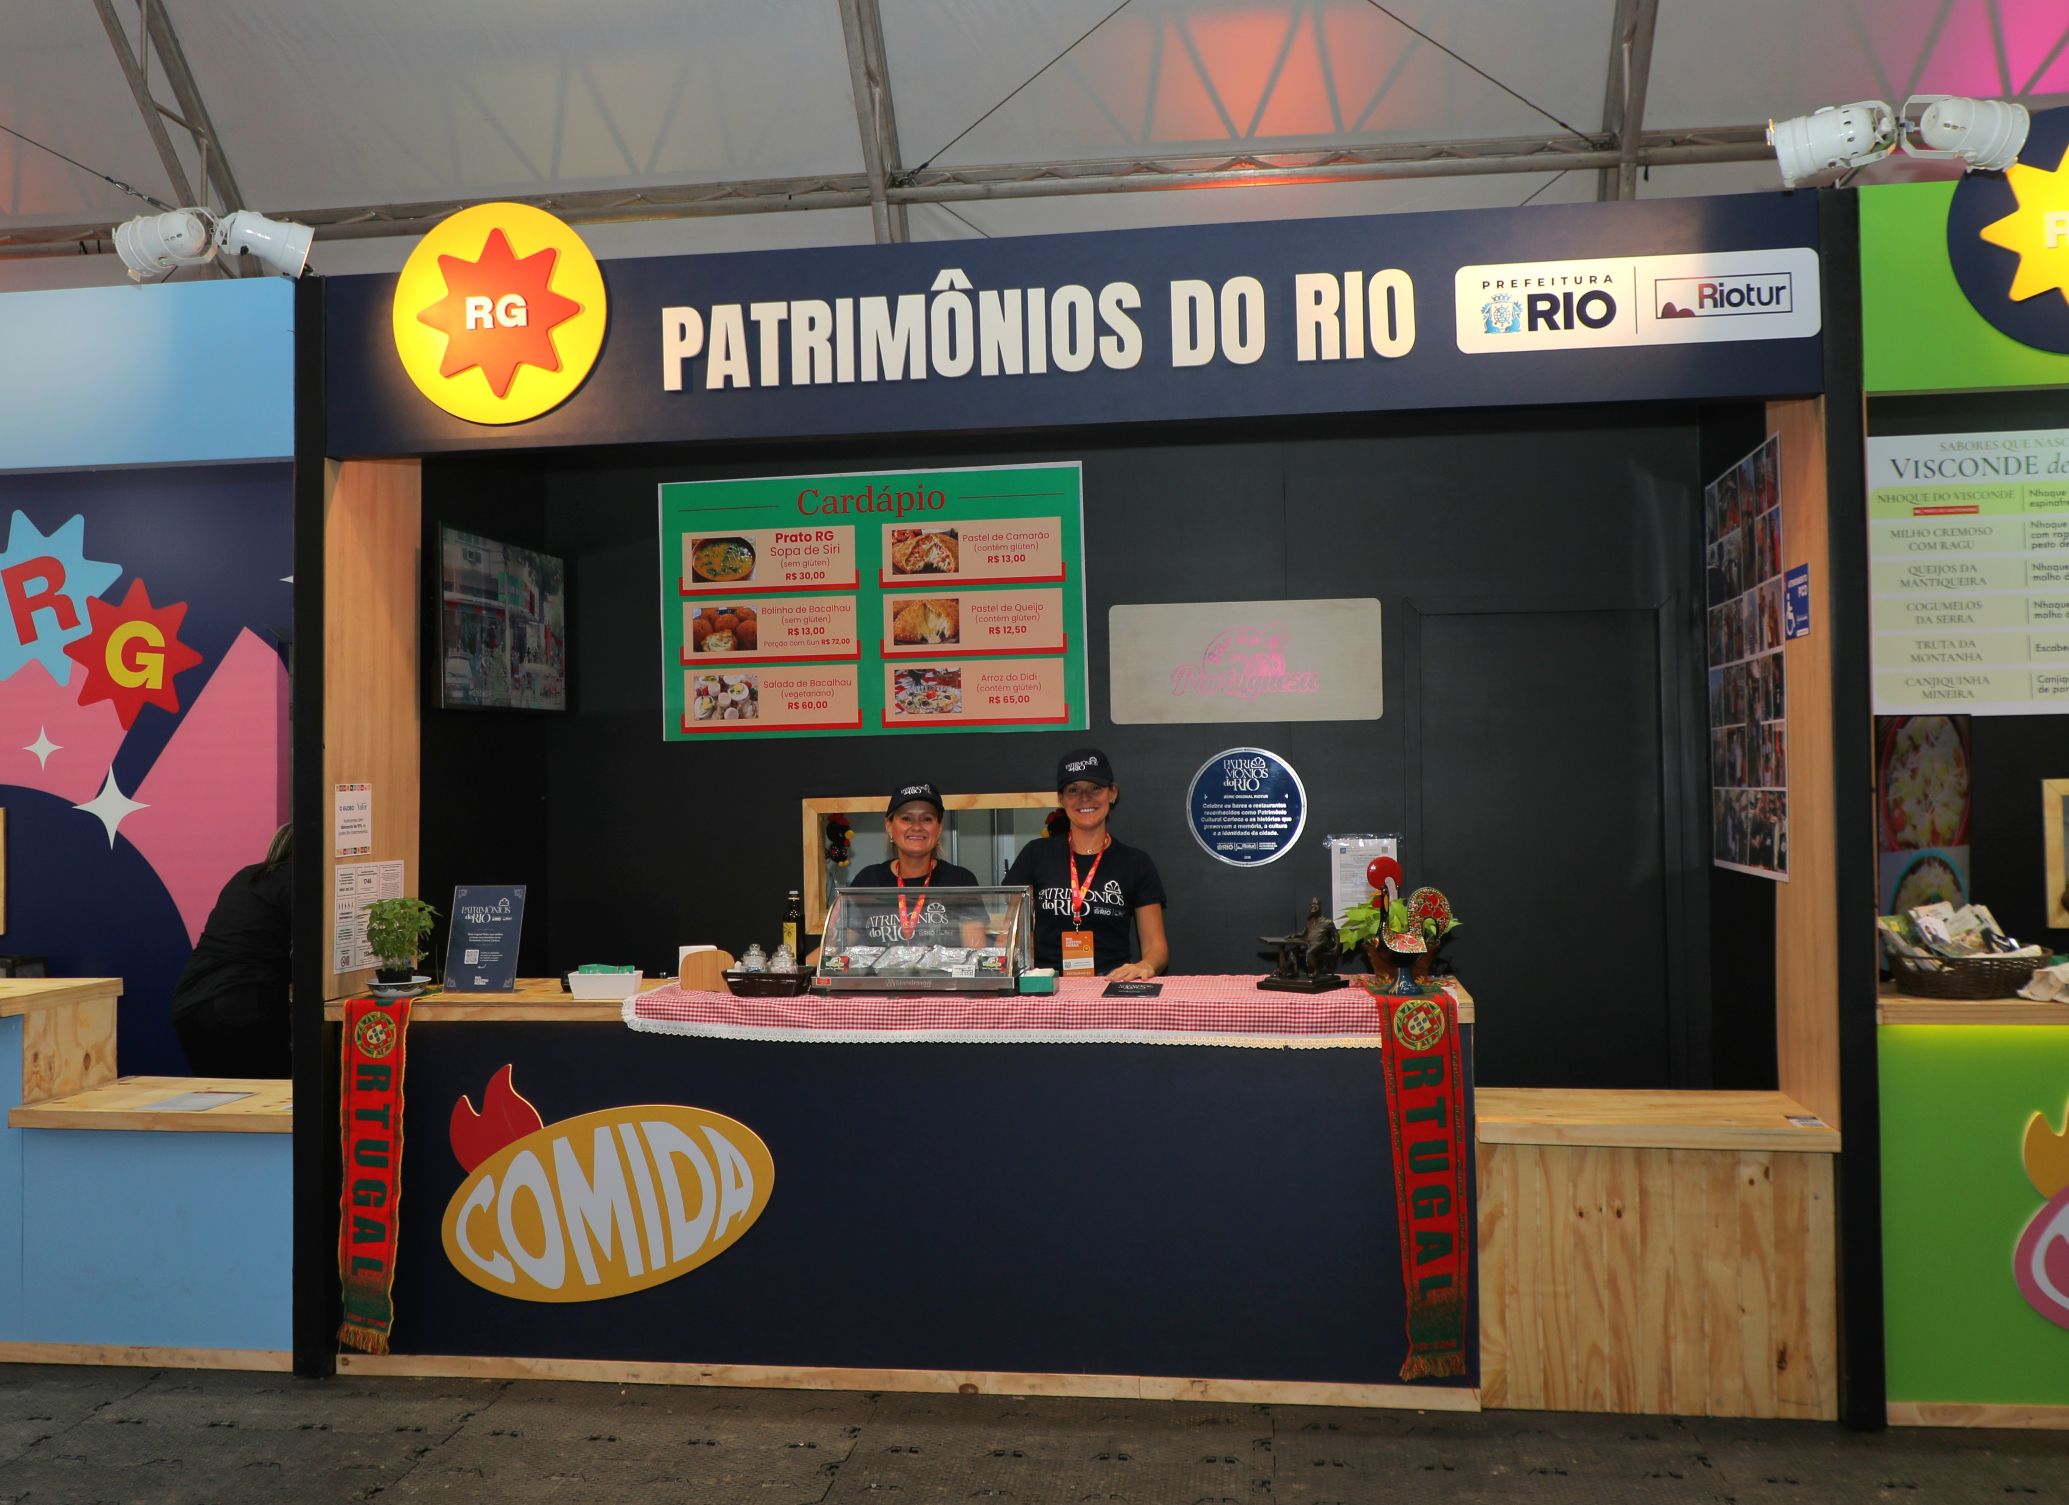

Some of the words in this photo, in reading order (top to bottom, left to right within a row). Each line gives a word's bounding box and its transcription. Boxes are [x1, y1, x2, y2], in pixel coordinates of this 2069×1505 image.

[1482, 274, 1613, 290] PREFEITURA
[1698, 282, 1787, 309] Riotur
[465, 294, 528, 331] RG
[1527, 289, 1617, 332] RIO
[662, 268, 1143, 391] PATRIMÔNIOS
[1170, 276, 1266, 367] DO
[1295, 268, 1417, 362] RIO
[1940, 440, 1999, 452] SABORES
[2001, 438, 2031, 452] QUE
[1890, 455, 2039, 480] VISCONDE
[797, 483, 946, 518] Cardápio
[1877, 493, 1930, 505] NHOQUE
[1933, 492, 1951, 502] DO
[1953, 490, 2015, 501] VISCONDE
[775, 531, 812, 544] Prato
[815, 530, 835, 542] RG
[962, 533, 991, 542] Pastel
[992, 533, 1004, 541] de
[1005, 531, 1050, 541] Camarão
[1890, 528, 1931, 539] MILHO
[1933, 526, 1994, 538] CREMOSO
[770, 546, 801, 559] Sopa
[804, 544, 820, 556] de
[823, 543, 840, 555] Siri
[974, 543, 1009, 553] (contém
[1010, 542, 1039, 552] glúten)
[1909, 541, 1937, 552] COM
[1940, 540, 1976, 550] RAGU
[780, 559, 801, 569] (sem
[802, 558, 831, 569] glúten)
[987, 555, 1000, 564] R$
[1001, 554, 1026, 564] 13,00
[785, 572, 798, 581] R$
[799, 571, 826, 581] 30,00
[1908, 564, 1957, 578] QUEIJOS
[1960, 564, 1978, 573] DA
[1900, 577, 1987, 590] MANTIQUEIRA
[761, 606, 794, 615] Bolinho
[796, 605, 807, 614] de
[809, 604, 851, 614] Bacalhau
[971, 604, 999, 613] Pastel
[1001, 603, 1013, 612] de
[1014, 602, 1044, 613] Queijo
[1906, 601, 1983, 612] COGUMELOS
[781, 616, 801, 626] (sem
[802, 615, 831, 625] glúten)
[975, 614, 1010, 624] (contém
[1011, 613, 1040, 624] glúten)
[1916, 615, 1933, 625] DA
[1936, 614, 1974, 624] SERRA
[787, 627, 800, 636] R$
[801, 626, 825, 636] 13,00
[988, 626, 1001, 635] R$
[1002, 625, 1027, 635] 12,50
[763, 640, 788, 649] Porção
[831, 637, 851, 646] 72,00
[1915, 640, 1956, 650] TRUTA
[1959, 640, 1977, 649] DA
[1910, 653, 1983, 663] MONTANHA
[981, 673, 1004, 682] Arroz
[1006, 673, 1018, 682] do
[1020, 672, 1038, 681] Didi
[1905, 676, 1991, 689] CANJIQUINHA
[763, 680, 794, 690] Salada
[797, 680, 808, 688] de
[809, 678, 852, 688] Bacalhau
[976, 684, 1011, 693] (contém
[1013, 683, 1042, 693] glúten)
[781, 688, 835, 700] (vegetariano)
[988, 696, 1001, 704] R$
[1003, 695, 1030, 704] 65,00
[1922, 690, 1975, 700] MINEIRA
[787, 701, 800, 710] R$
[801, 700, 828, 710] 60,00
[455, 1120, 755, 1290] COMIDA
